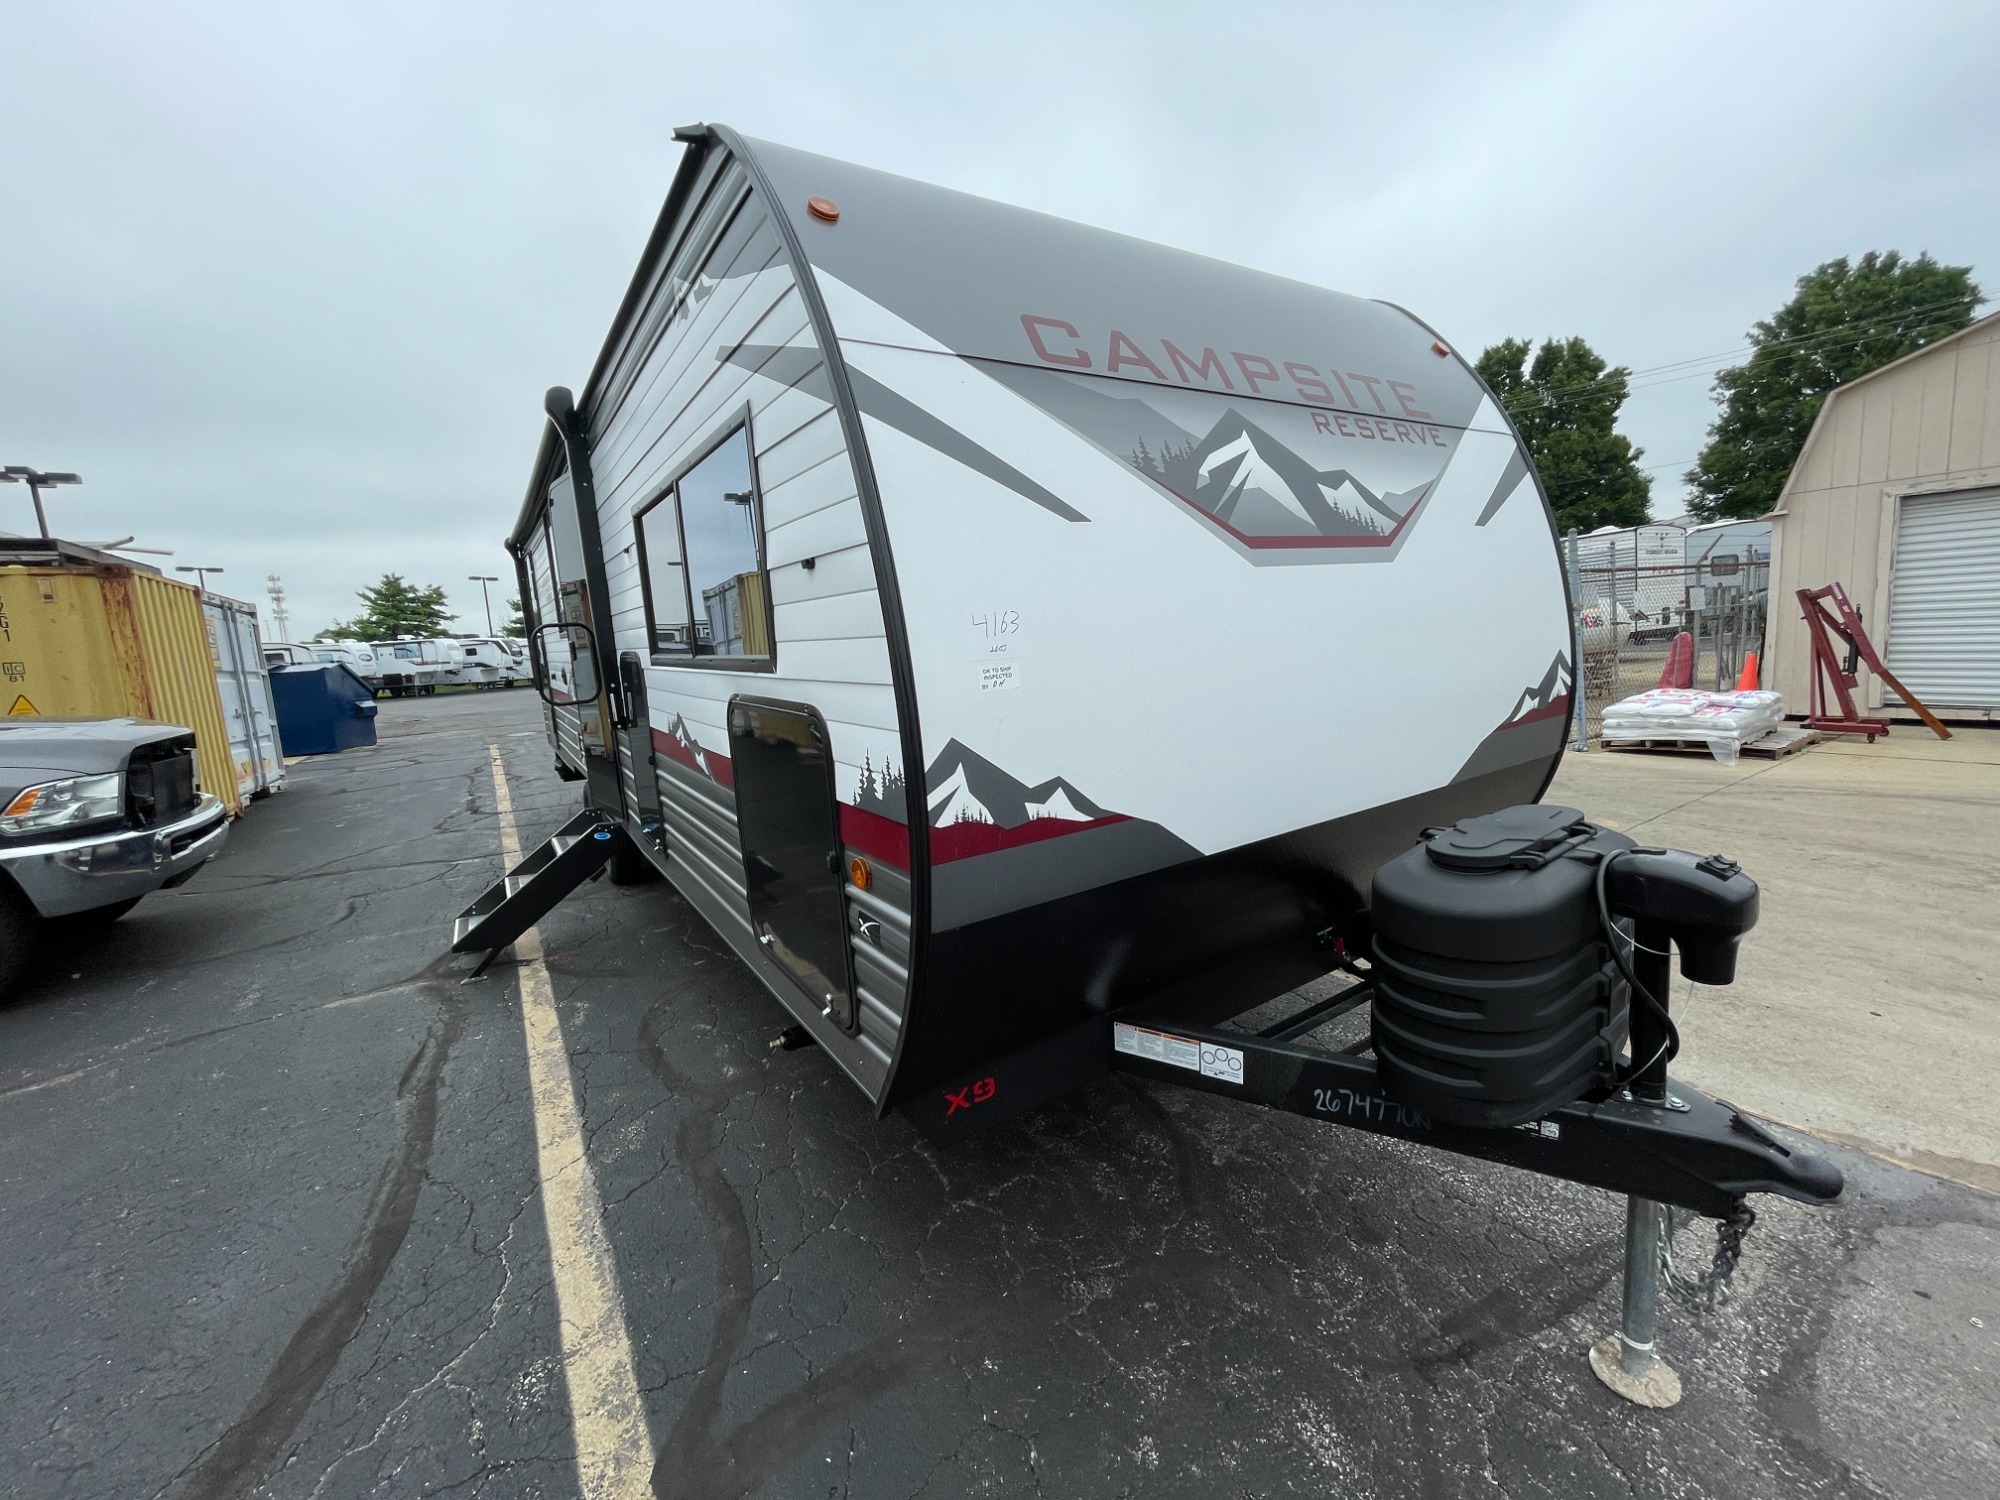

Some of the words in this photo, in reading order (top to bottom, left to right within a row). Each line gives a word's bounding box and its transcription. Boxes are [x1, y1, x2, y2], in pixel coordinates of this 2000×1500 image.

[1019, 314, 1433, 419] CAMPSITE
[1310, 412, 1447, 448] RESERVE
[971, 610, 1020, 639] 4163
[983, 672, 1013, 681] INSPECTED
[944, 1076, 997, 1117] X9
